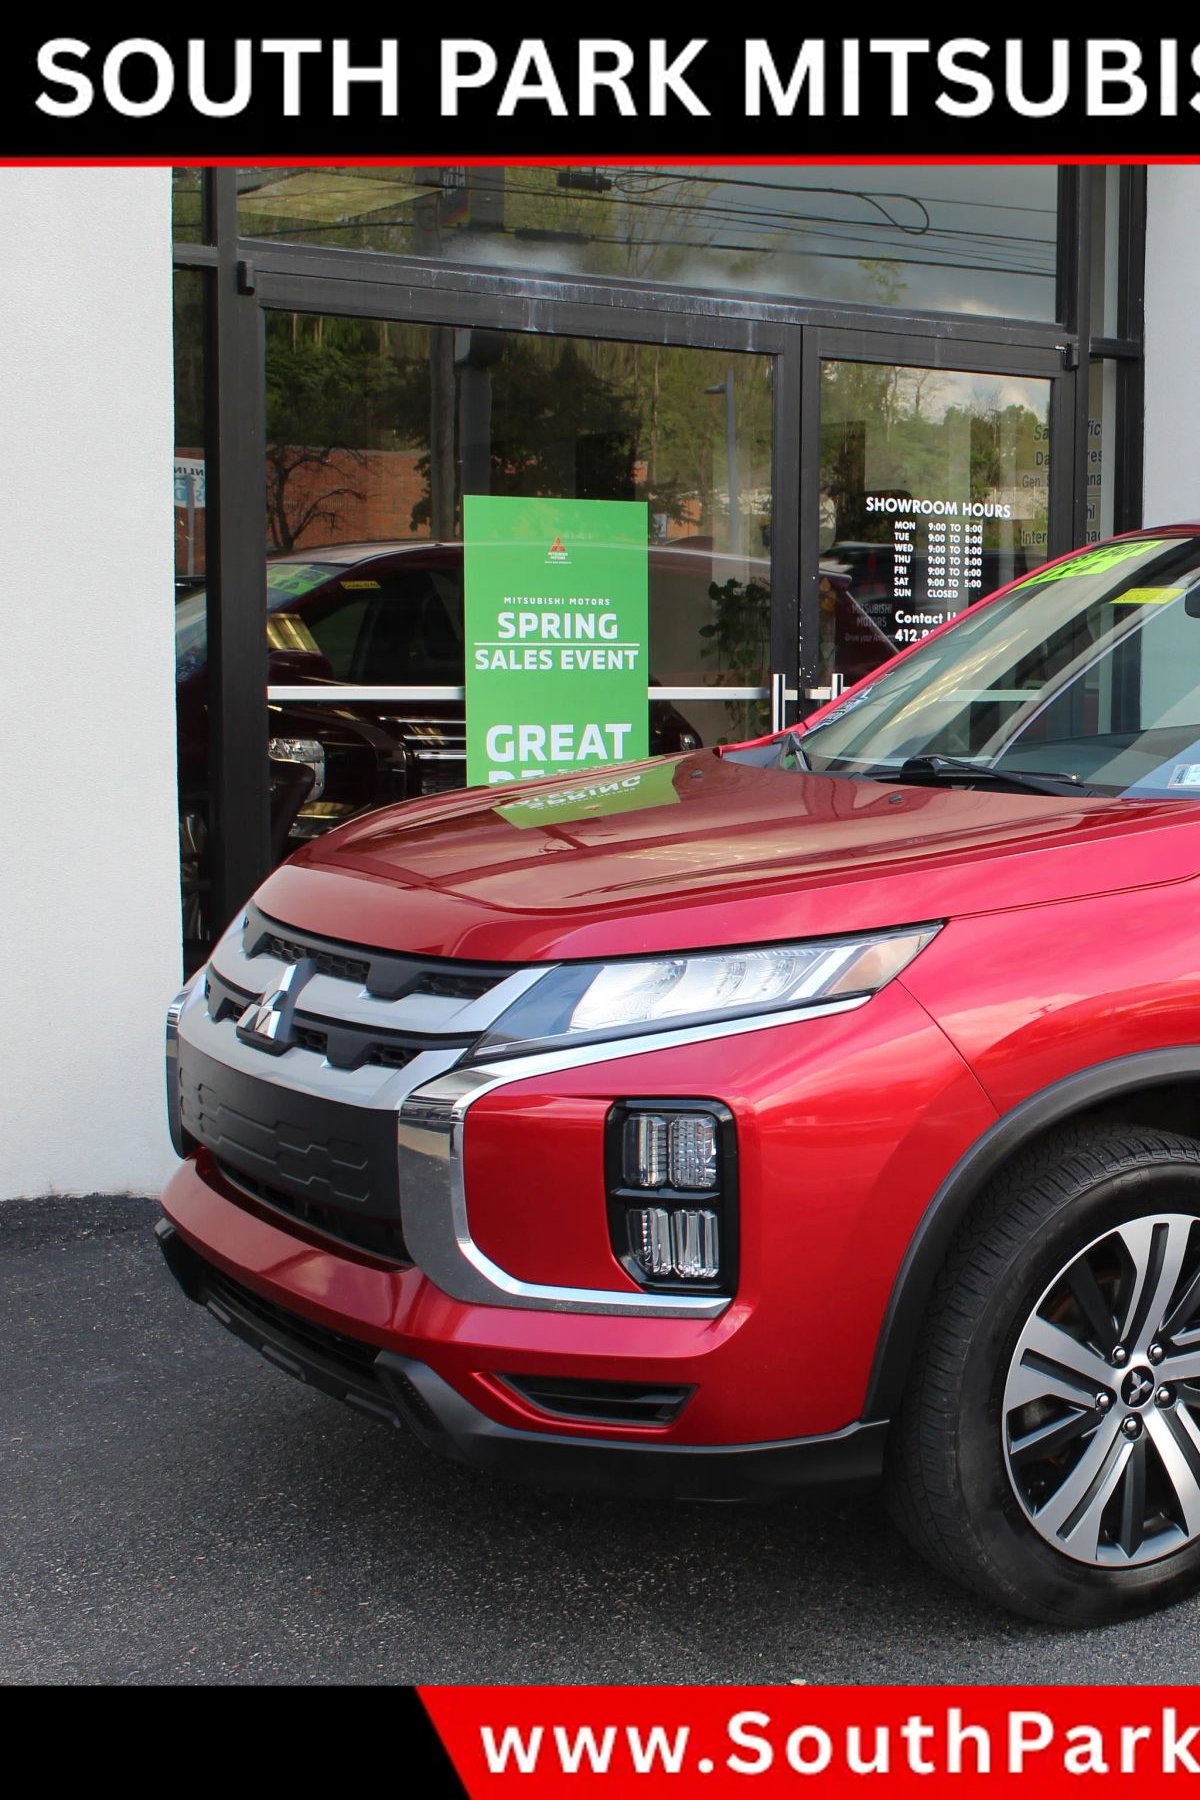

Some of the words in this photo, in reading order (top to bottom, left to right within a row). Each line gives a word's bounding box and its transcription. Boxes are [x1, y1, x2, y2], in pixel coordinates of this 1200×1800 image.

[866, 497, 958, 515] SHOWROOM
[962, 502, 1011, 518] HOURS
[895, 521, 916, 531] MON
[929, 523, 946, 531] 9:00
[950, 524, 961, 532] TO
[965, 525, 982, 533] 8:00
[895, 532, 909, 540] TUE
[928, 534, 945, 542] 9:00
[950, 535, 960, 543] TO
[965, 535, 982, 543] 8:00
[928, 545, 945, 553] 9:00
[950, 546, 960, 554] TO
[895, 555, 910, 563] THU
[928, 556, 945, 564] 9:00
[950, 557, 960, 565] TO
[965, 557, 982, 565] 8:00
[895, 566, 906, 574] FRI
[928, 567, 945, 575] 9:00
[949, 568, 960, 576] TO
[895, 577, 908, 585] SAT
[928, 578, 944, 586] 9:00
[948, 579, 959, 587] TO
[928, 590, 958, 598] CLOSED
[503, 596, 565, 605] MITSUBISHI
[569, 598, 611, 606] MOTORS
[895, 610, 943, 624] Contact
[497, 612, 618, 639] SPRING
[475, 649, 553, 670] SALES
[560, 650, 639, 670] EVENT
[486, 723, 633, 764] GREAT
